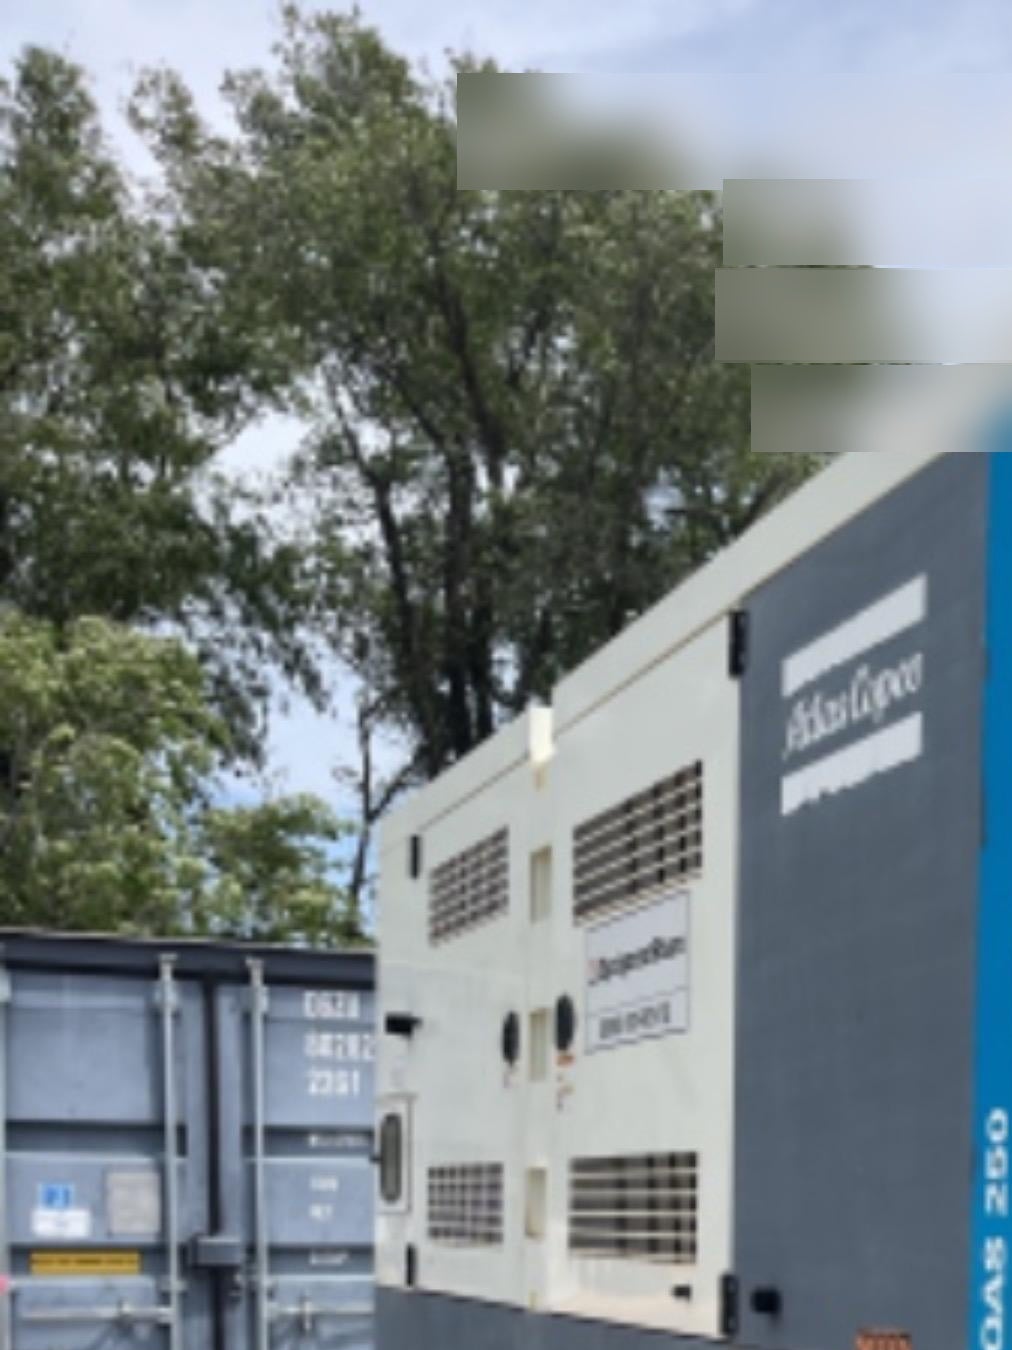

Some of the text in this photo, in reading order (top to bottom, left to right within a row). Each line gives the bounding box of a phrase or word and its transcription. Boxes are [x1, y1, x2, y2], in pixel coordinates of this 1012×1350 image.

[781, 653, 924, 763] Atlas Copco
[984, 1107, 1009, 1217] 250
